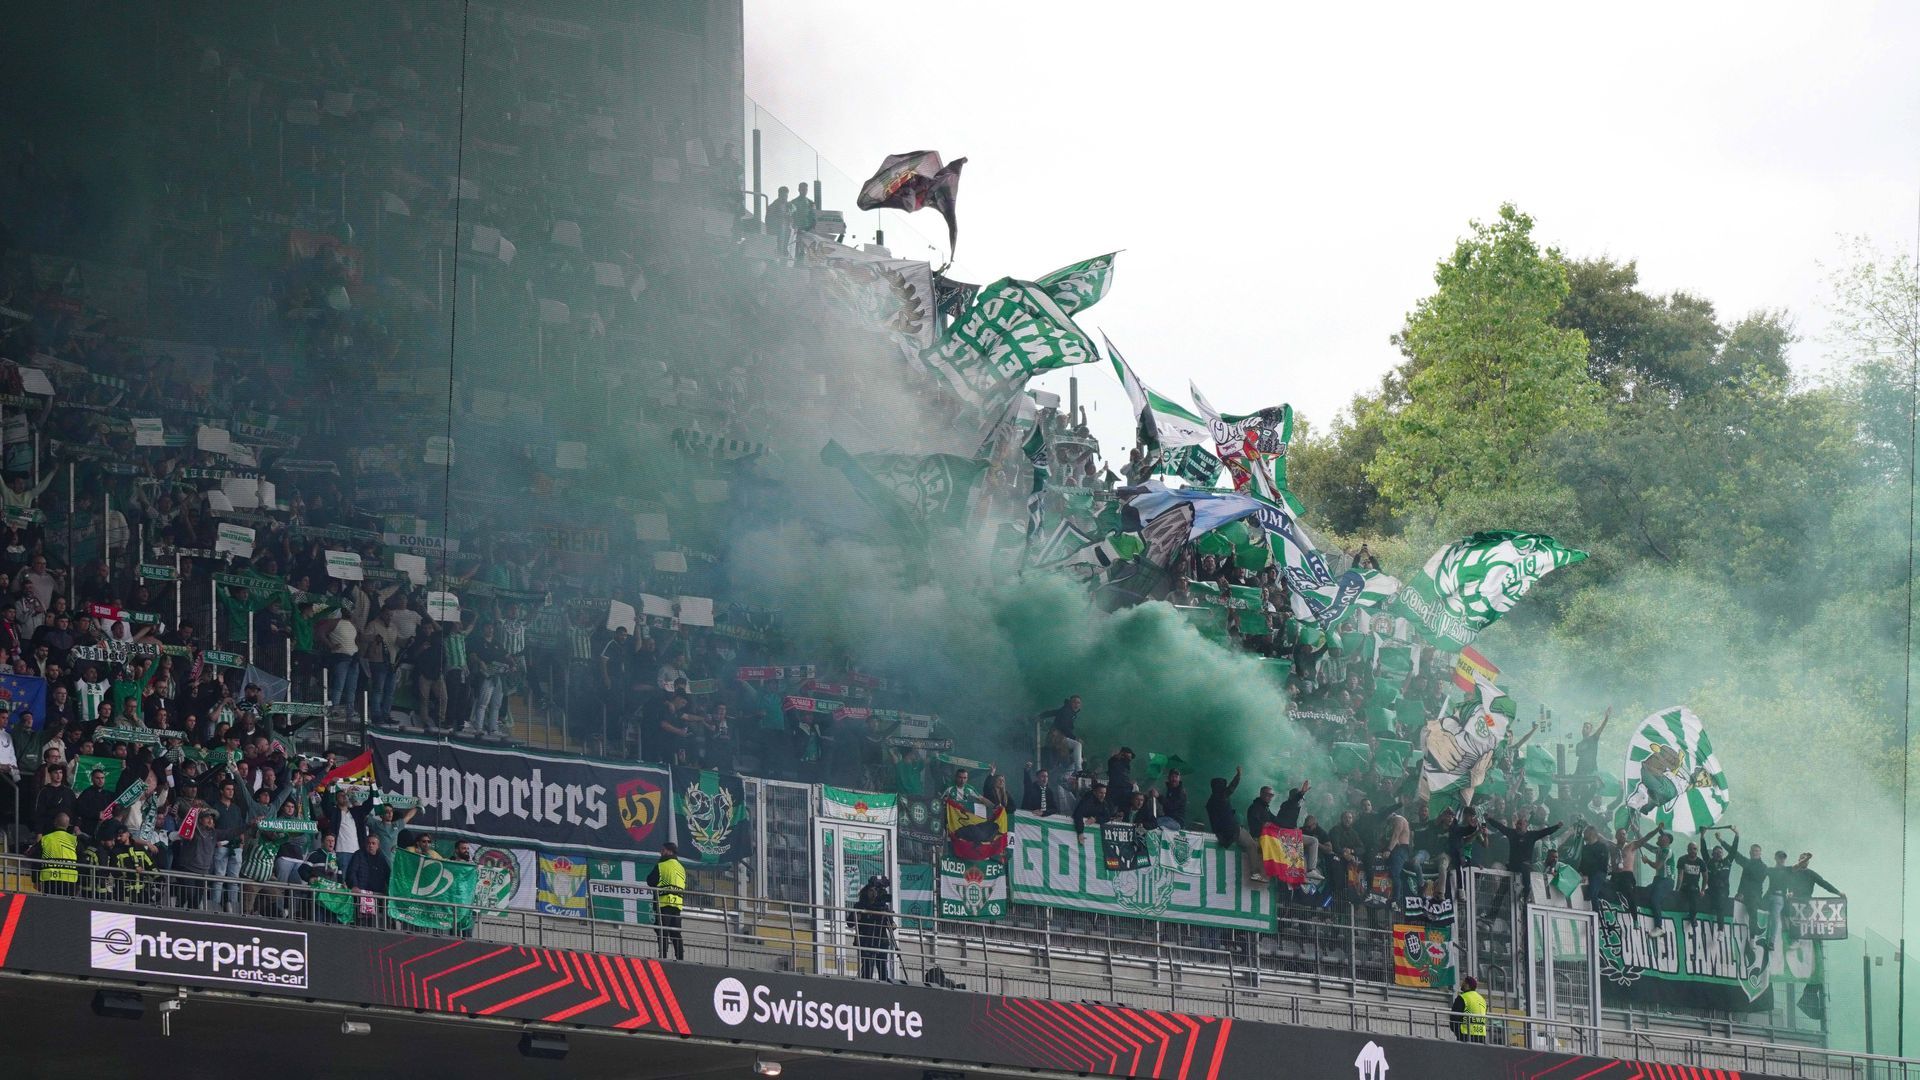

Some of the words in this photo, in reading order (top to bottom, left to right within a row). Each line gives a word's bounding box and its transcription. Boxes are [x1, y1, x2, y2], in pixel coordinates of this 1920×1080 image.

[399, 534, 443, 548] RONDA
[387, 749, 608, 830] Supporters
[941, 858, 966, 875] NÚCLEO
[592, 884, 631, 895] FUENTES
[942, 900, 968, 916] ÉCIJA
[105, 928, 305, 972] enterprise
[1616, 911, 1679, 975] UNITED
[1682, 919, 1750, 980] FAMILY
[232, 968, 304, 985] rent-a-car
[753, 984, 923, 1041] Swissquote
